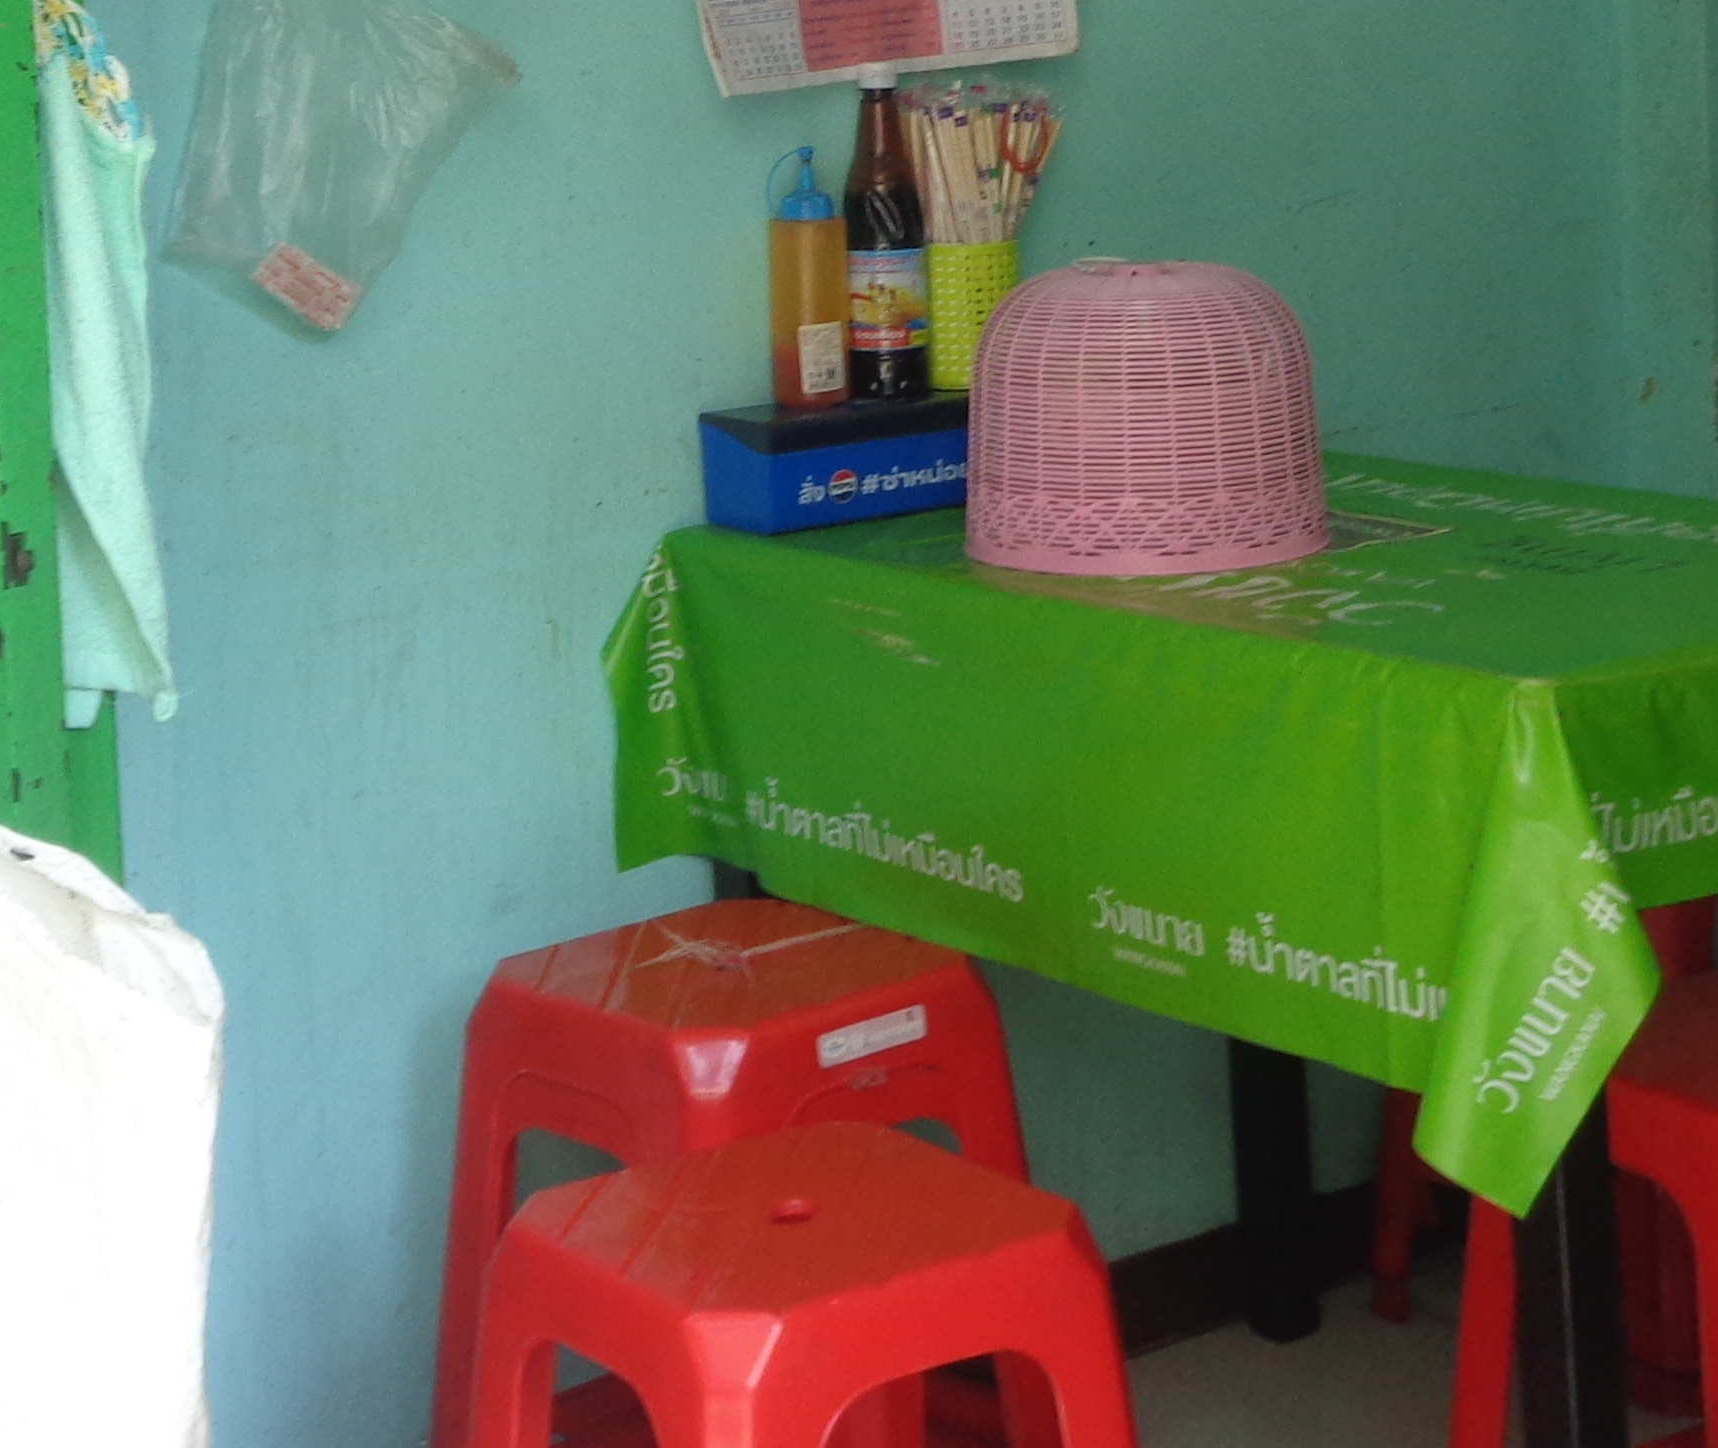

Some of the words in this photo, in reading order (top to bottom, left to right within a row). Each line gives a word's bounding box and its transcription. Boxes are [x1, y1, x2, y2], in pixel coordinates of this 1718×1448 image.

[797, 474, 826, 505] สั่ง
[745, 776, 1025, 904] #น้ำตาลที่ไม่เหมือนใคร
[1086, 884, 1206, 957] วังขนาย
[1470, 945, 1597, 1115] วังขนาย
